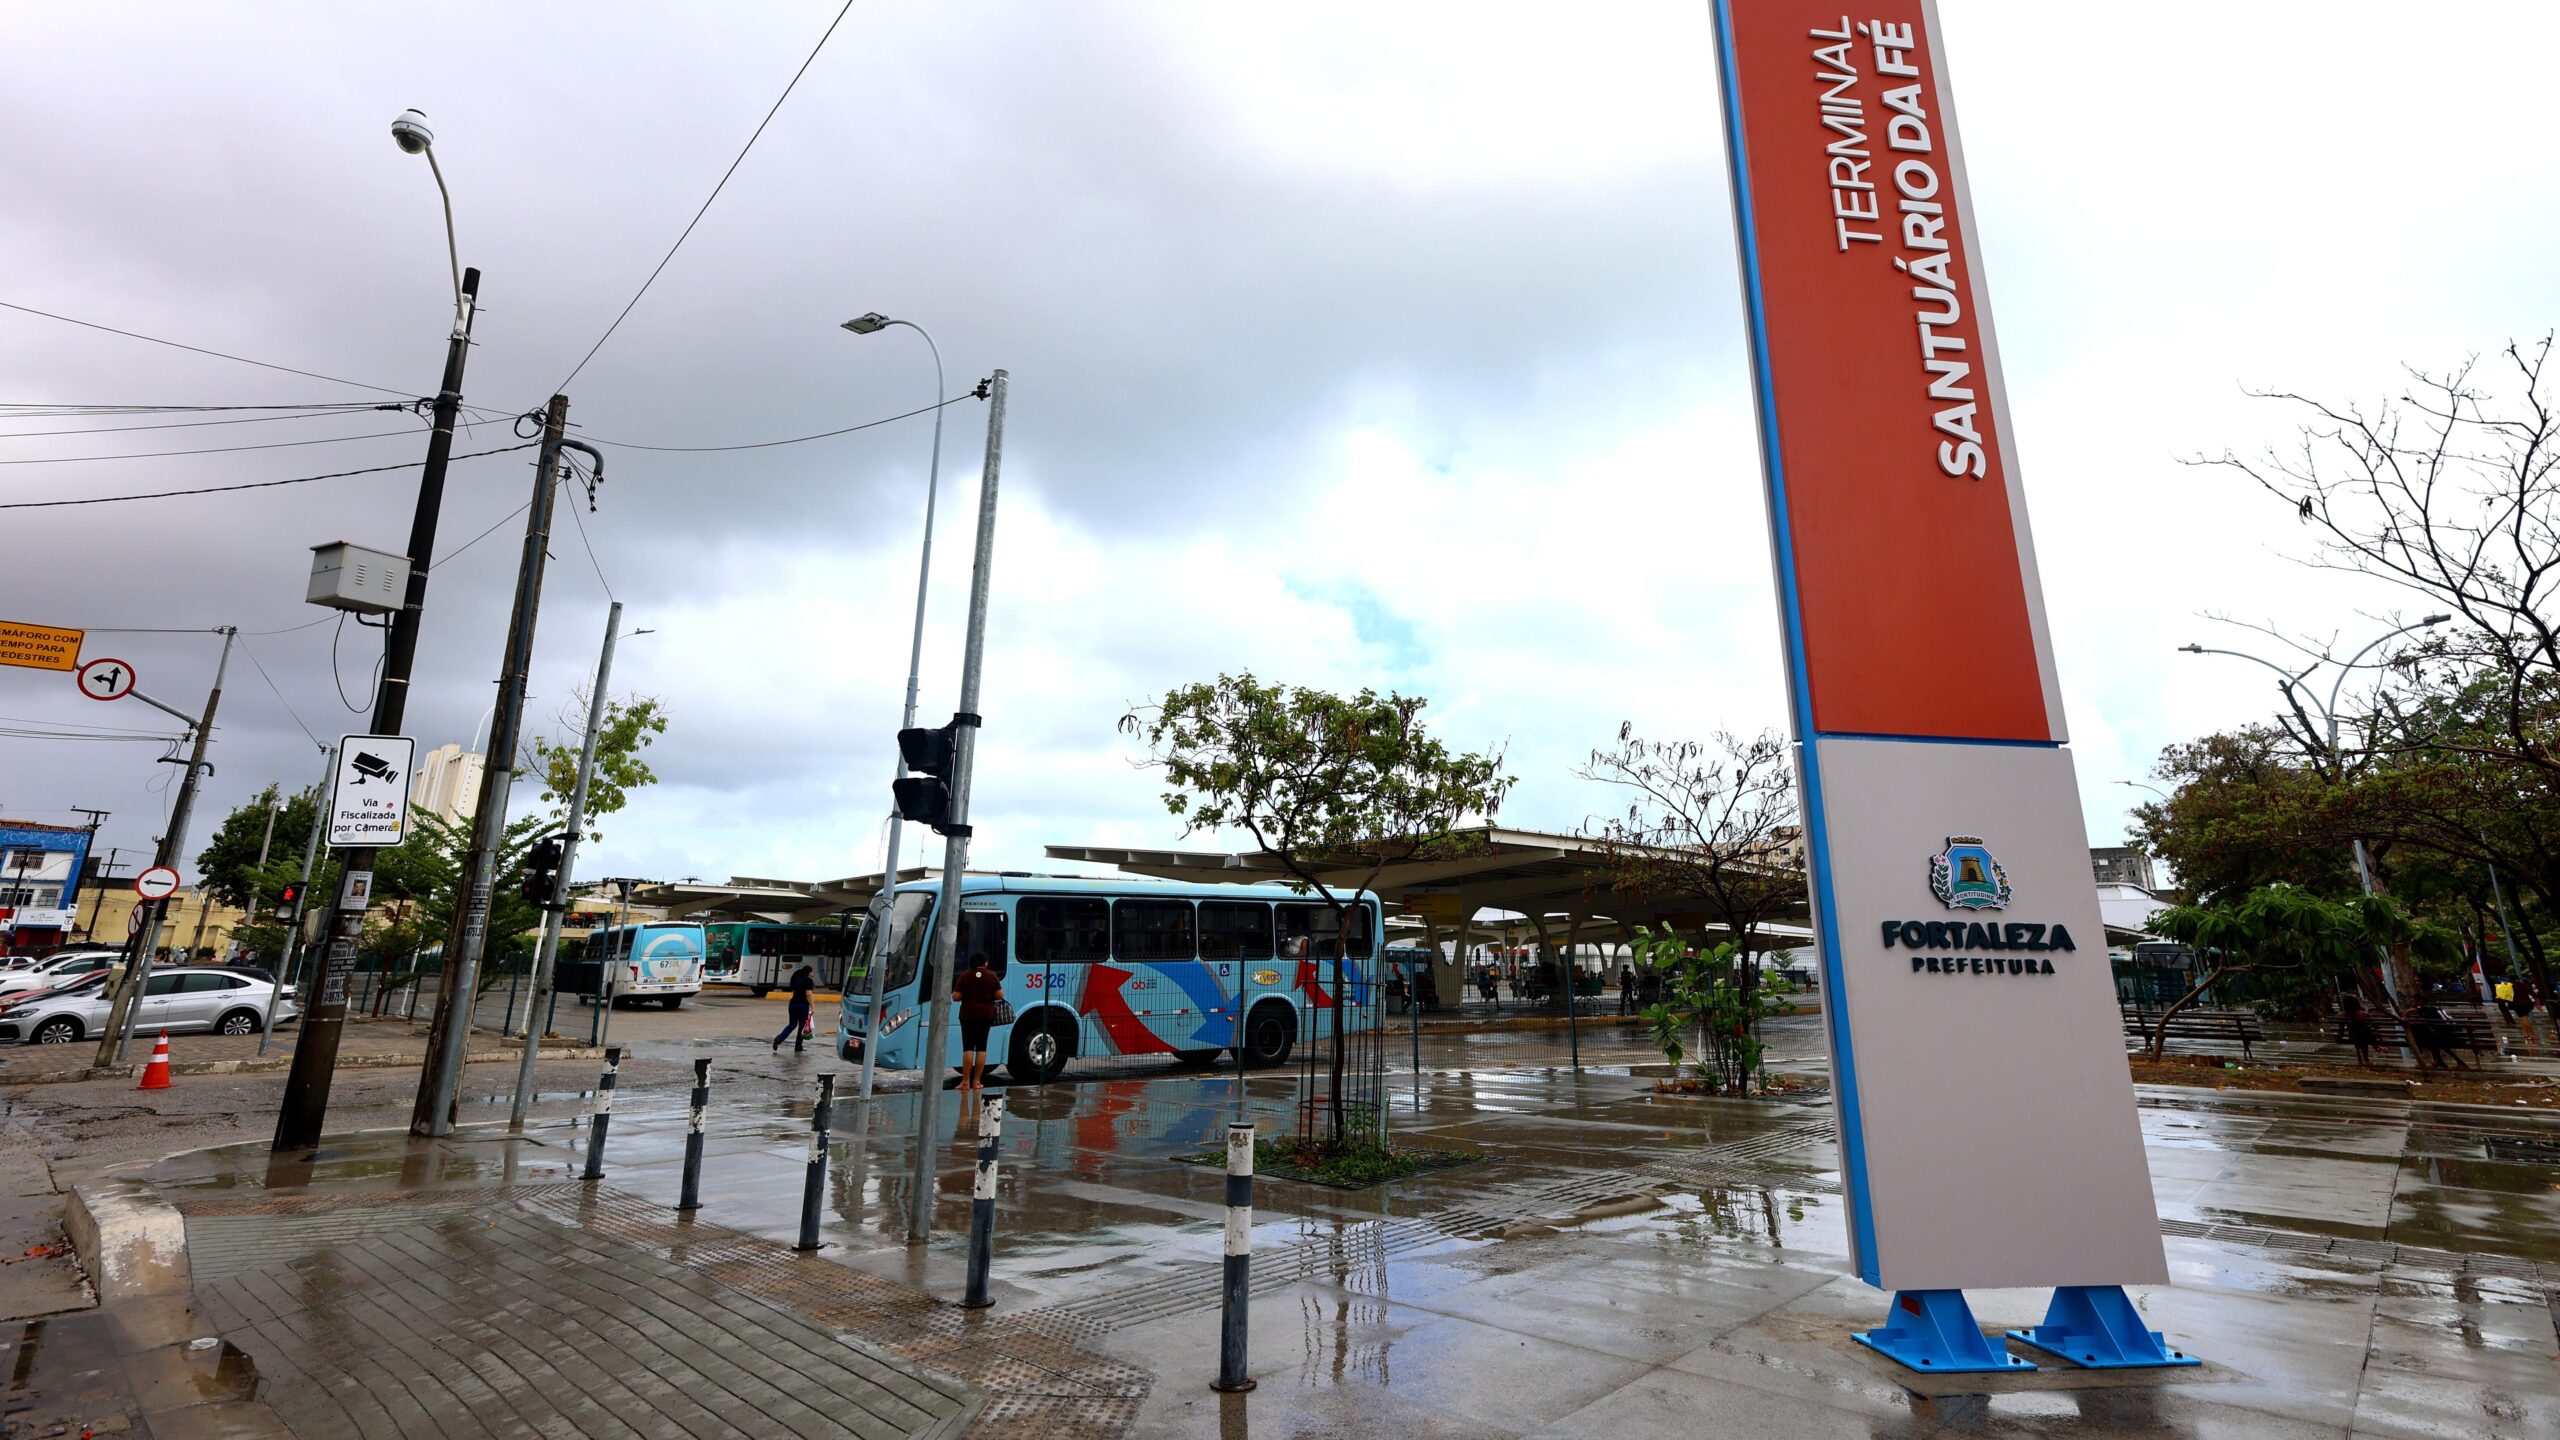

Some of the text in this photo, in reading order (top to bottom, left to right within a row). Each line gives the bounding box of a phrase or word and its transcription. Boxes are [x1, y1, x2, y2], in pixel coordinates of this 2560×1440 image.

[1809, 15, 1883, 251] TERMINAL
[1857, 19, 1987, 480] SANTUÁRIO DA FÉ
[0, 629, 79, 644] MÁFORO COM
[0, 640, 65, 653] EMPO PARA
[0, 651, 60, 663] EDESTRES
[363, 799, 378, 807] Via
[341, 811, 396, 820] Fiscalizada
[334, 824, 351, 834] por
[1956, 891, 1995, 900] FORTITUDINE
[1882, 920, 2076, 951] FORTALEZA
[1912, 957, 2056, 974] PREFEITURA
